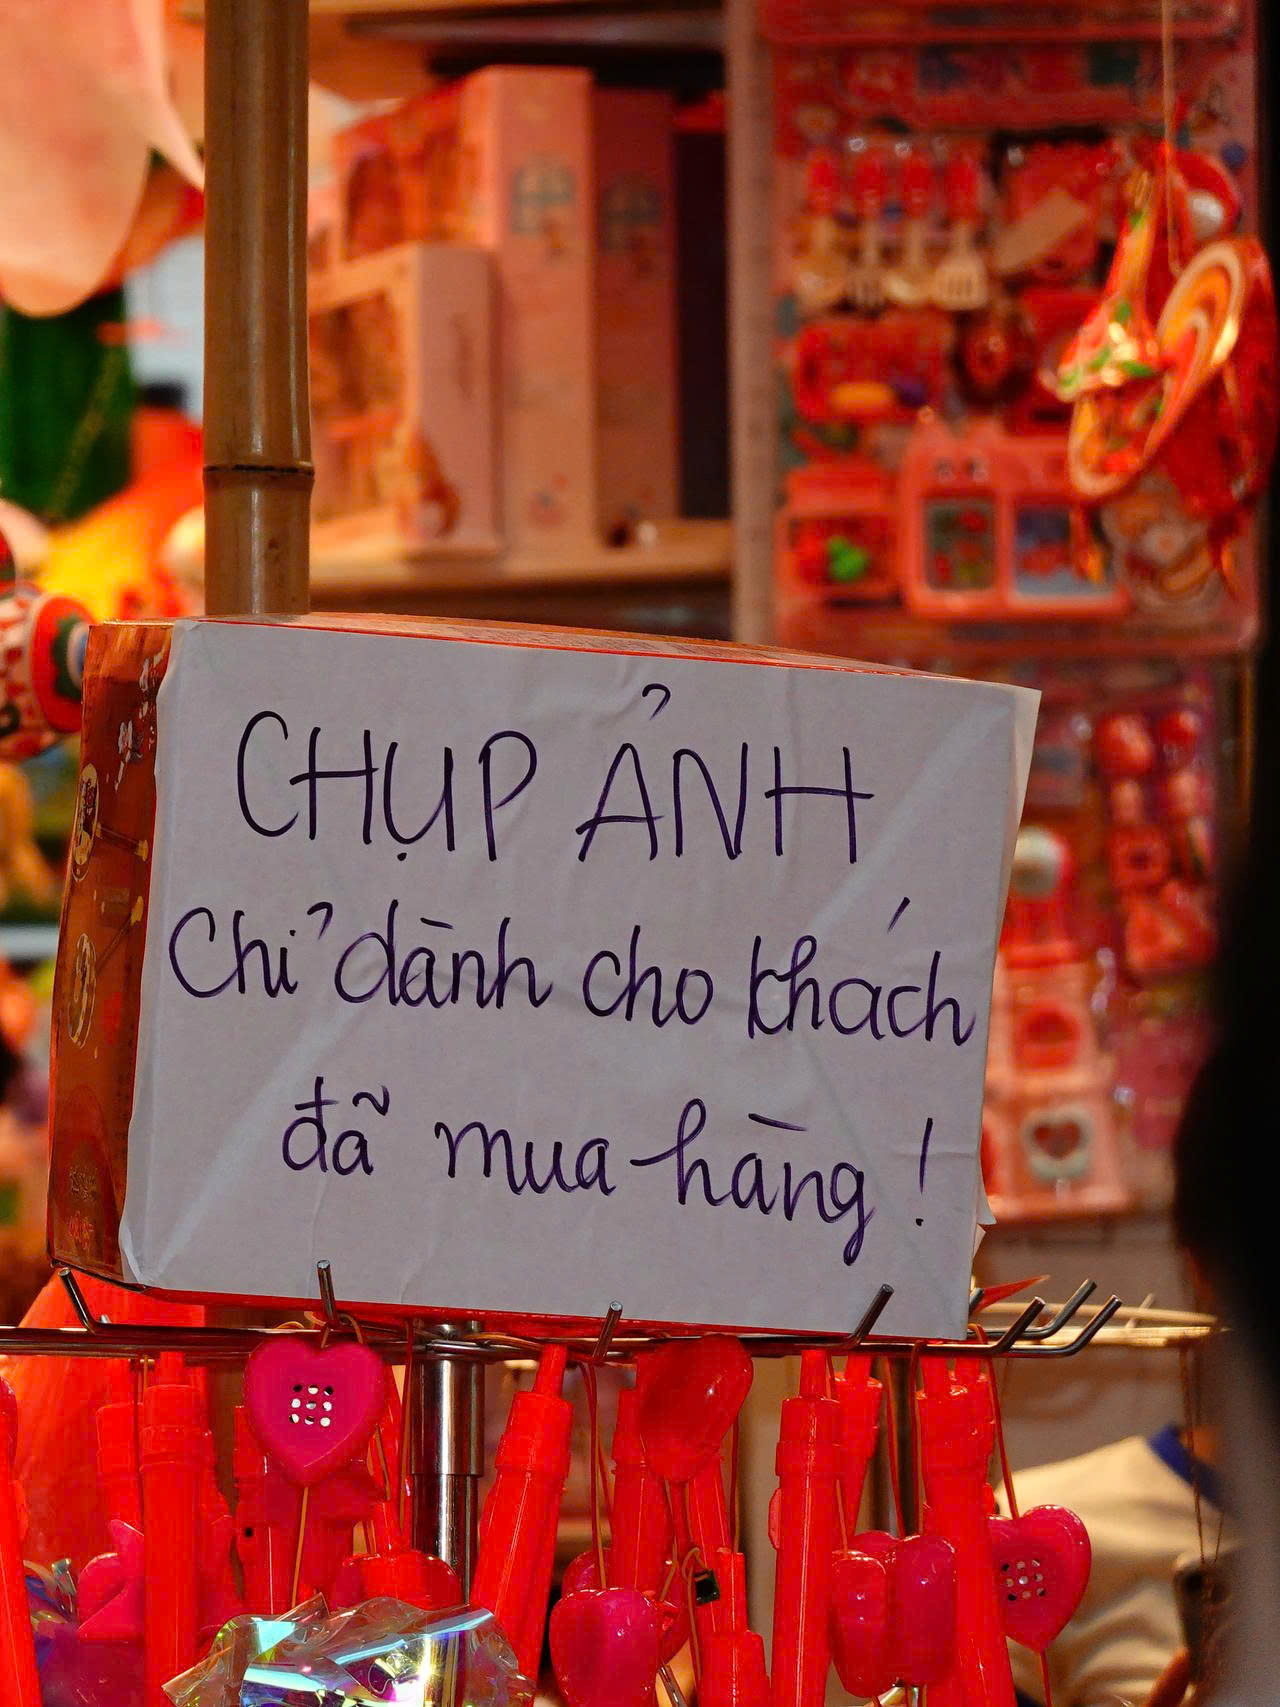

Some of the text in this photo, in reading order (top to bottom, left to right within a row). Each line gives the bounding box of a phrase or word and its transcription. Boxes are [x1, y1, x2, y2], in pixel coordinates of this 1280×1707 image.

[236, 682, 876, 865] CHỤP ẢNH
[333, 898, 554, 1010] dành
[582, 924, 714, 1029] cho
[747, 896, 977, 1047] khách
[281, 1075, 391, 1177] đã
[433, 1121, 617, 1197] mua
